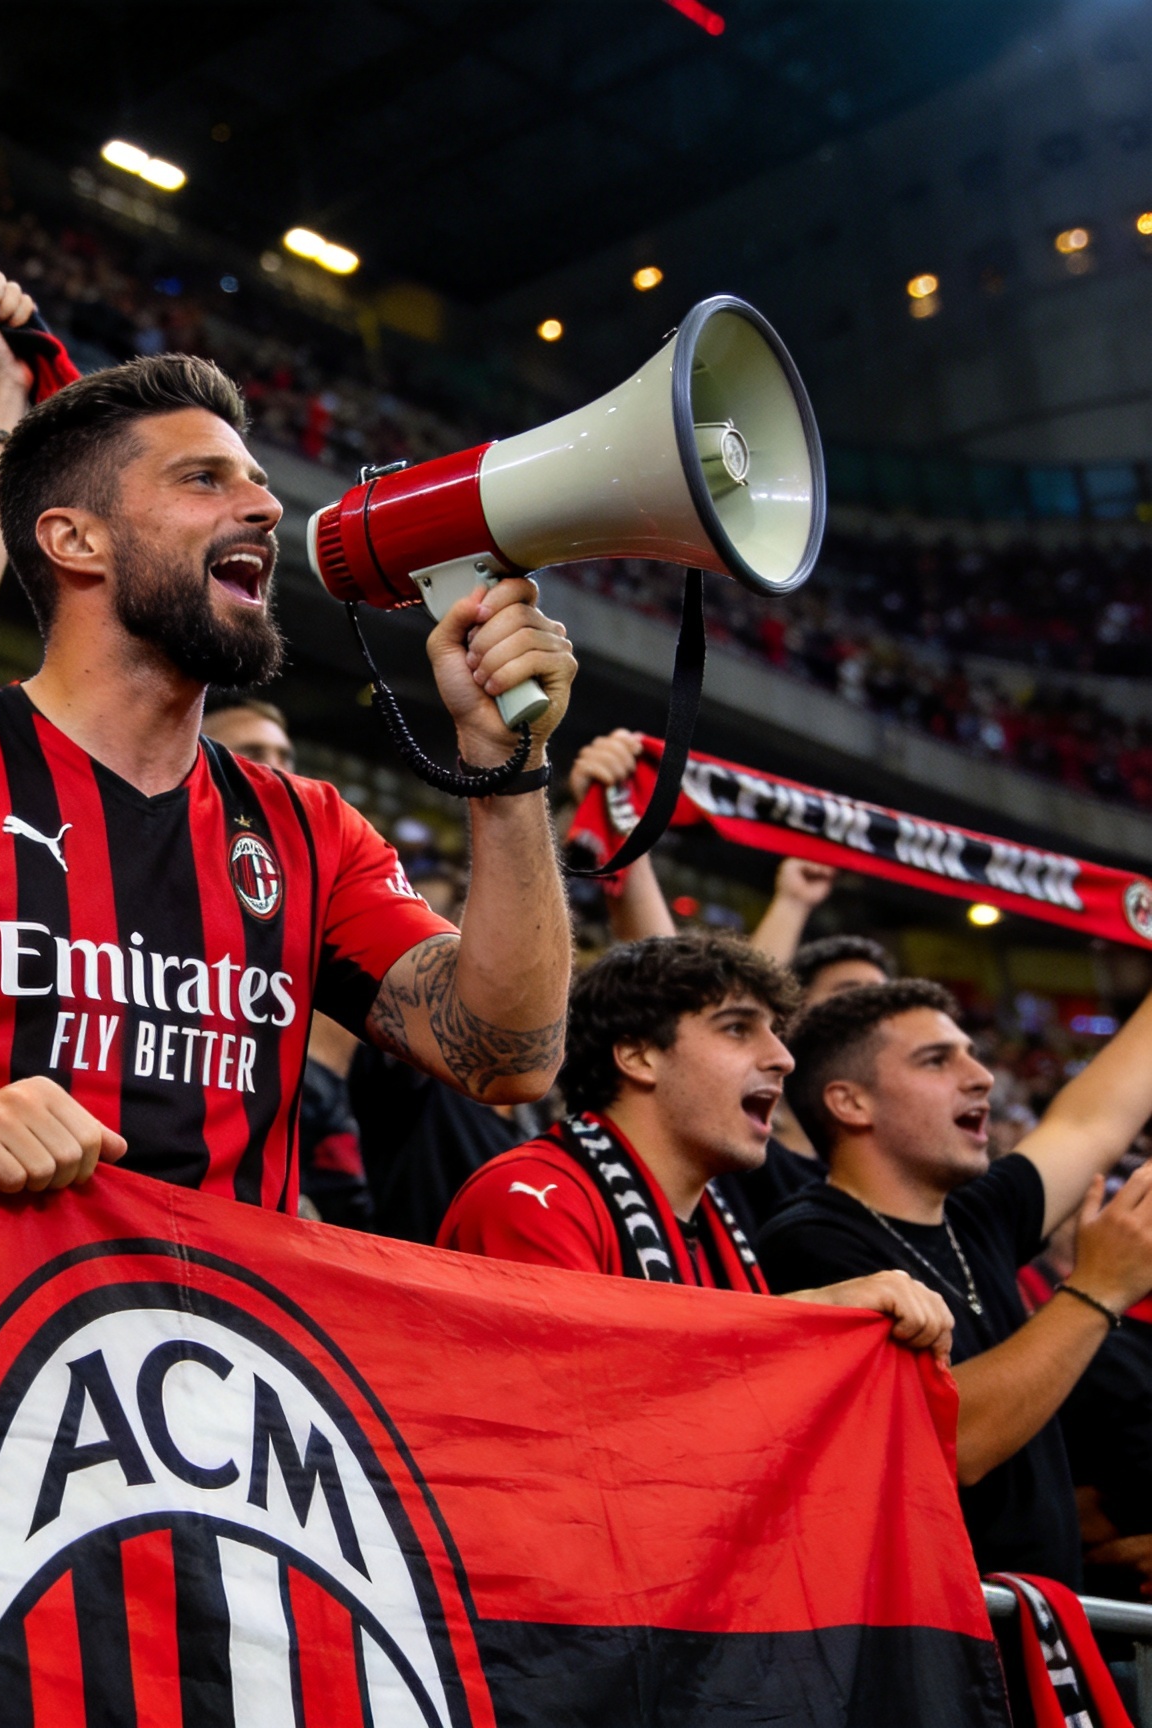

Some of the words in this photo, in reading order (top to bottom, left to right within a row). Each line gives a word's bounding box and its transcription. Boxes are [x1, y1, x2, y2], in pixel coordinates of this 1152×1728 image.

[49, 1012, 119, 1072] FLY
[134, 1020, 257, 1094] BETTER
[25, 1339, 372, 1583] ACM
